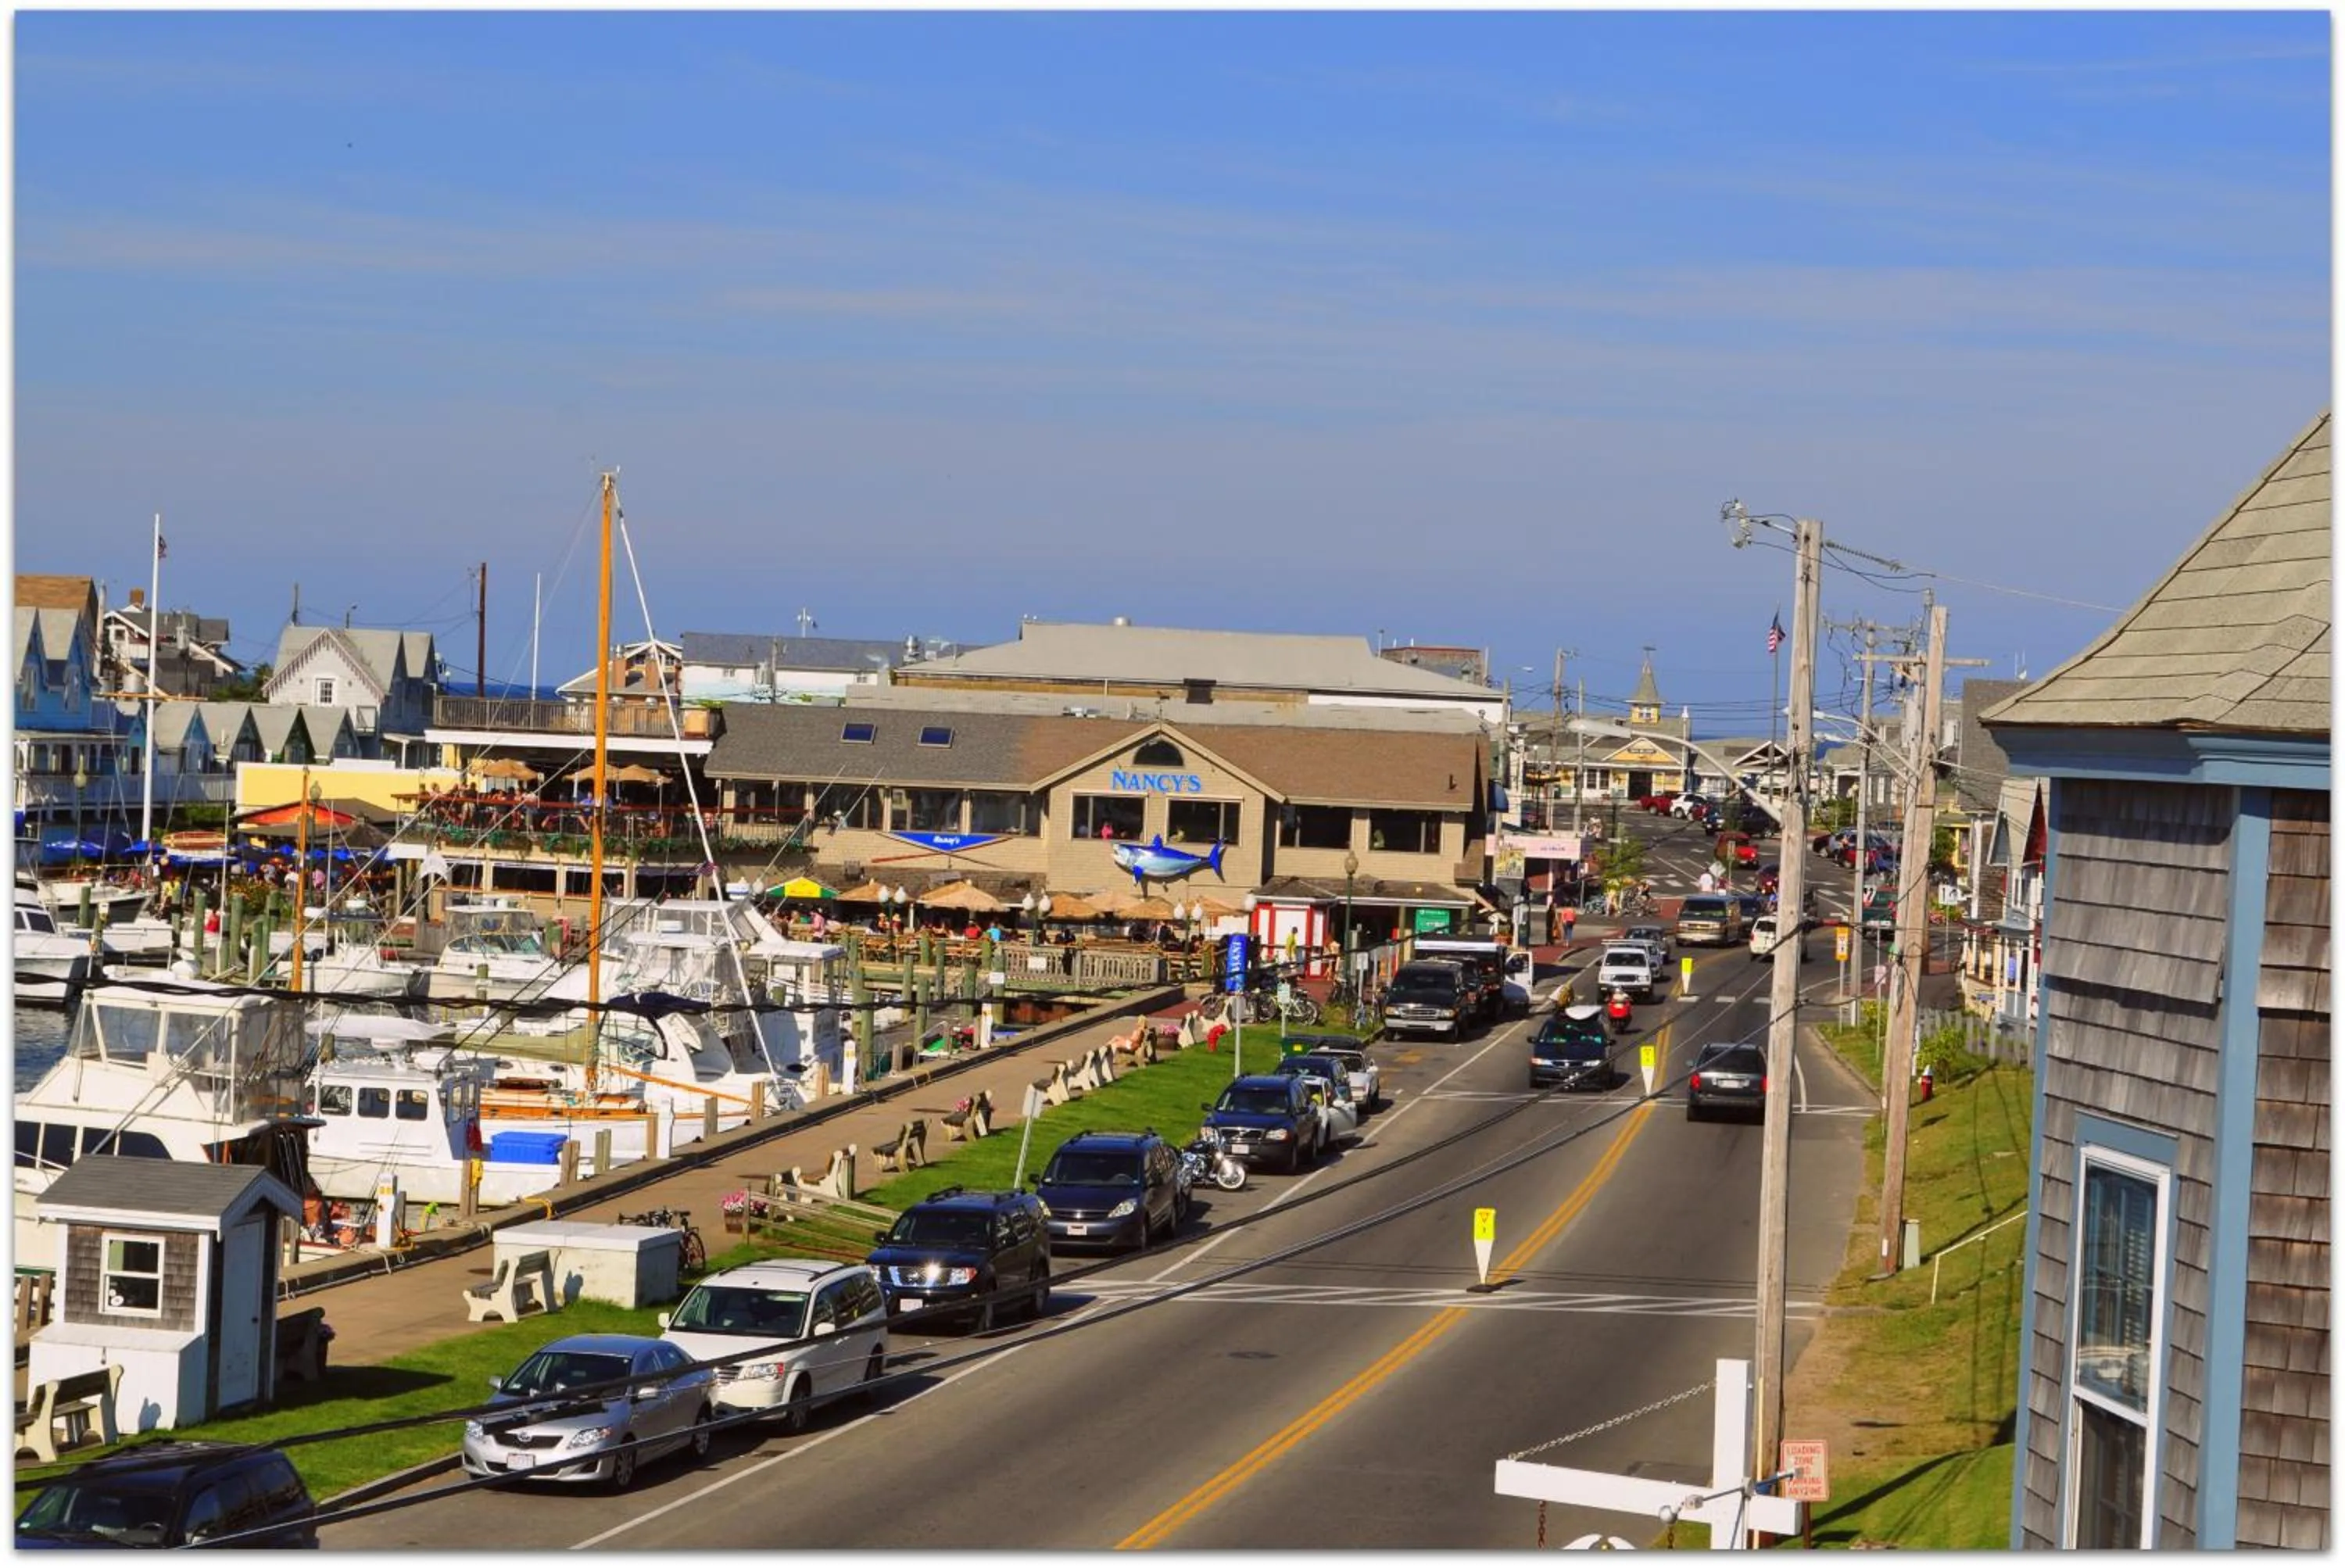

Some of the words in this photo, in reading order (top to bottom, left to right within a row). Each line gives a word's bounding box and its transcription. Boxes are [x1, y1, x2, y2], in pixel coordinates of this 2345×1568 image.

[1112, 770, 1202, 792] NANCY'S
[1786, 1445, 1821, 1454] LOADING
[1794, 1456, 1814, 1465] ZONE
